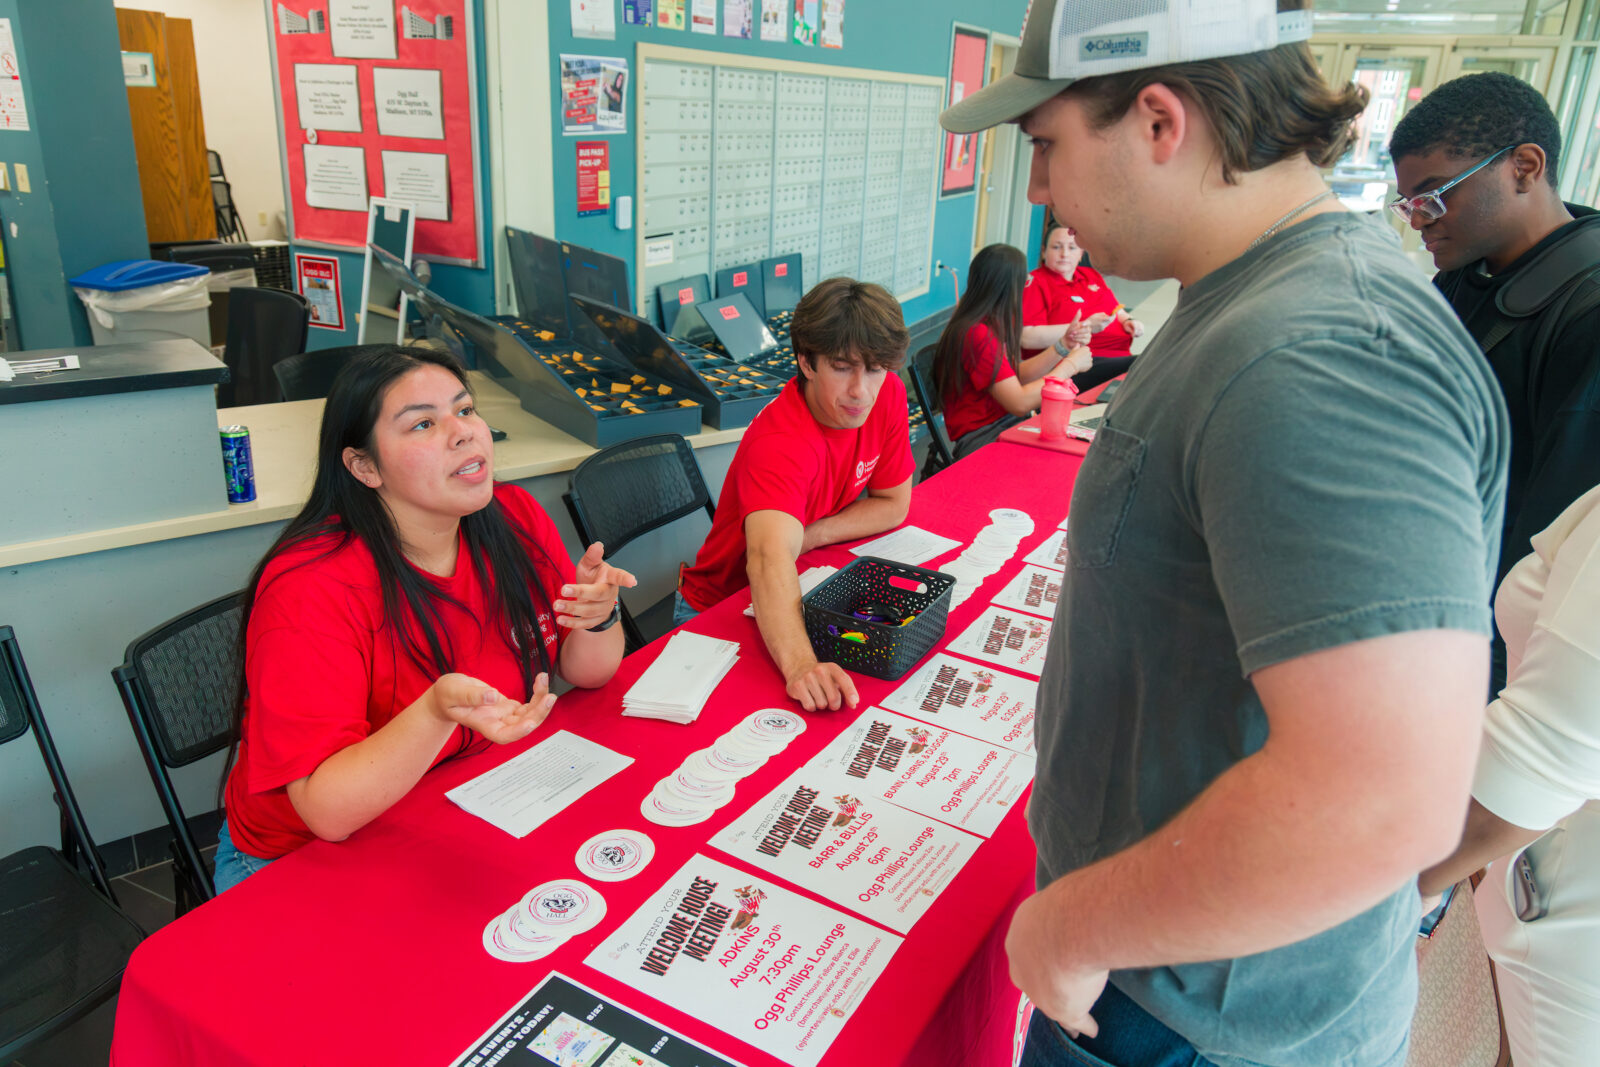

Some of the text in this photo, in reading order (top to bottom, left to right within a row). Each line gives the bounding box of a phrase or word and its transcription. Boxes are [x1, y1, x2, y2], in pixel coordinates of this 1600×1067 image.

[1095, 37, 1141, 51] Columbia
[578, 148, 605, 157] BUS PASS
[578, 159, 602, 167] PICK-UP
[934, 664, 960, 686] HOUSE
[945, 677, 974, 708] MEETING!
[919, 682, 950, 713] WELCOME
[845, 720, 892, 779] WELCOME HOUSE
[875, 736, 909, 773] MEETING!
[915, 764, 942, 788] August
[940, 794, 959, 813] Ogg
[956, 773, 979, 802] Phillips
[972, 750, 998, 776] Lounge
[942, 767, 962, 783] 7pm
[752, 793, 789, 841] ATTEND YOUR
[755, 785, 820, 858] WELCOME HOUSE
[791, 805, 834, 850] MEETING!
[808, 811, 873, 869] BARR & BULLIS
[836, 841, 869, 871] August
[867, 846, 891, 865] 6pm
[858, 883, 884, 902] Ogg
[875, 855, 909, 884] Phillips
[901, 826, 935, 857] Lounge
[636, 888, 682, 954] ATTEND YOUR
[639, 875, 719, 977] WELCOME HOUSE
[681, 901, 734, 962] MEETING!
[718, 924, 760, 968] ADKINS
[730, 924, 782, 988] August 30th
[758, 944, 802, 985] 7:30pm
[843, 977, 853, 990] with
[851, 966, 862, 977] any
[859, 937, 881, 967] questions!
[847, 947, 860, 961] Ellie
[754, 923, 846, 1030] Ogg Phillips Lounge
[785, 943, 850, 1022] Contact House Fellow Bianca
[513, 1004, 554, 1040] TODAY!
[586, 1003, 604, 1021] 8/27
[479, 1015, 525, 1057] EVENTS
[650, 1035, 669, 1055] 8/29
